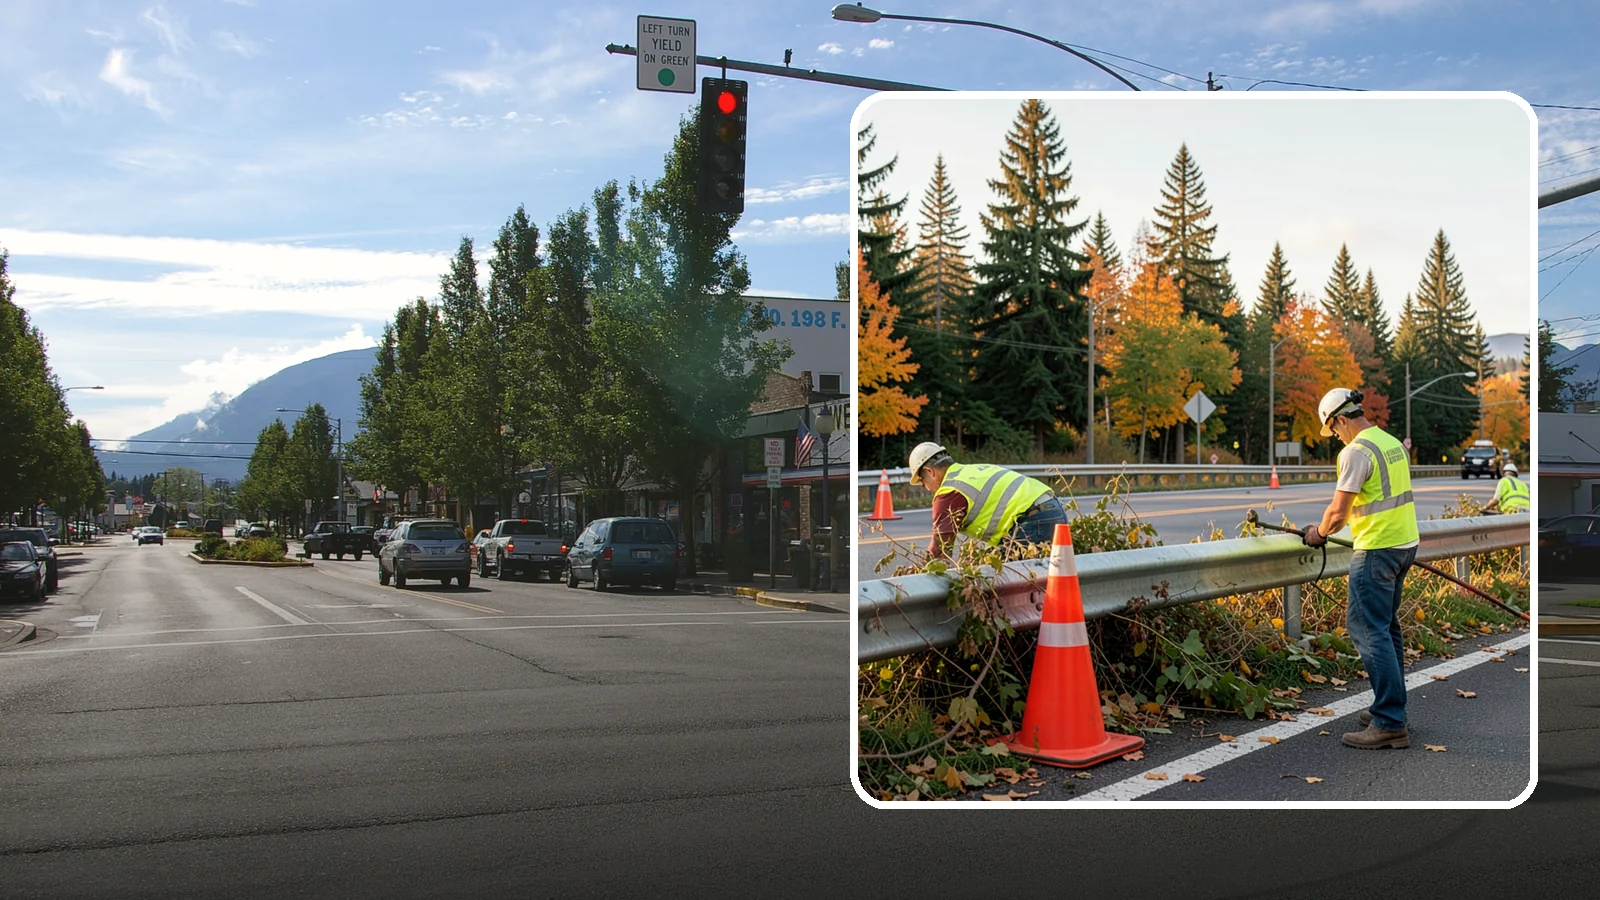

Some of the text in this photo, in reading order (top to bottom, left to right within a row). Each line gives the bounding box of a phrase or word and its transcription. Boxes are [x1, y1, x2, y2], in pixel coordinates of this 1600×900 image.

[643, 23, 690, 36] LEFT TURN
[652, 38, 682, 52] YIELD
[644, 53, 689, 66] ON GREEN
[791, 309, 826, 328] 198
[831, 311, 846, 329] F.
